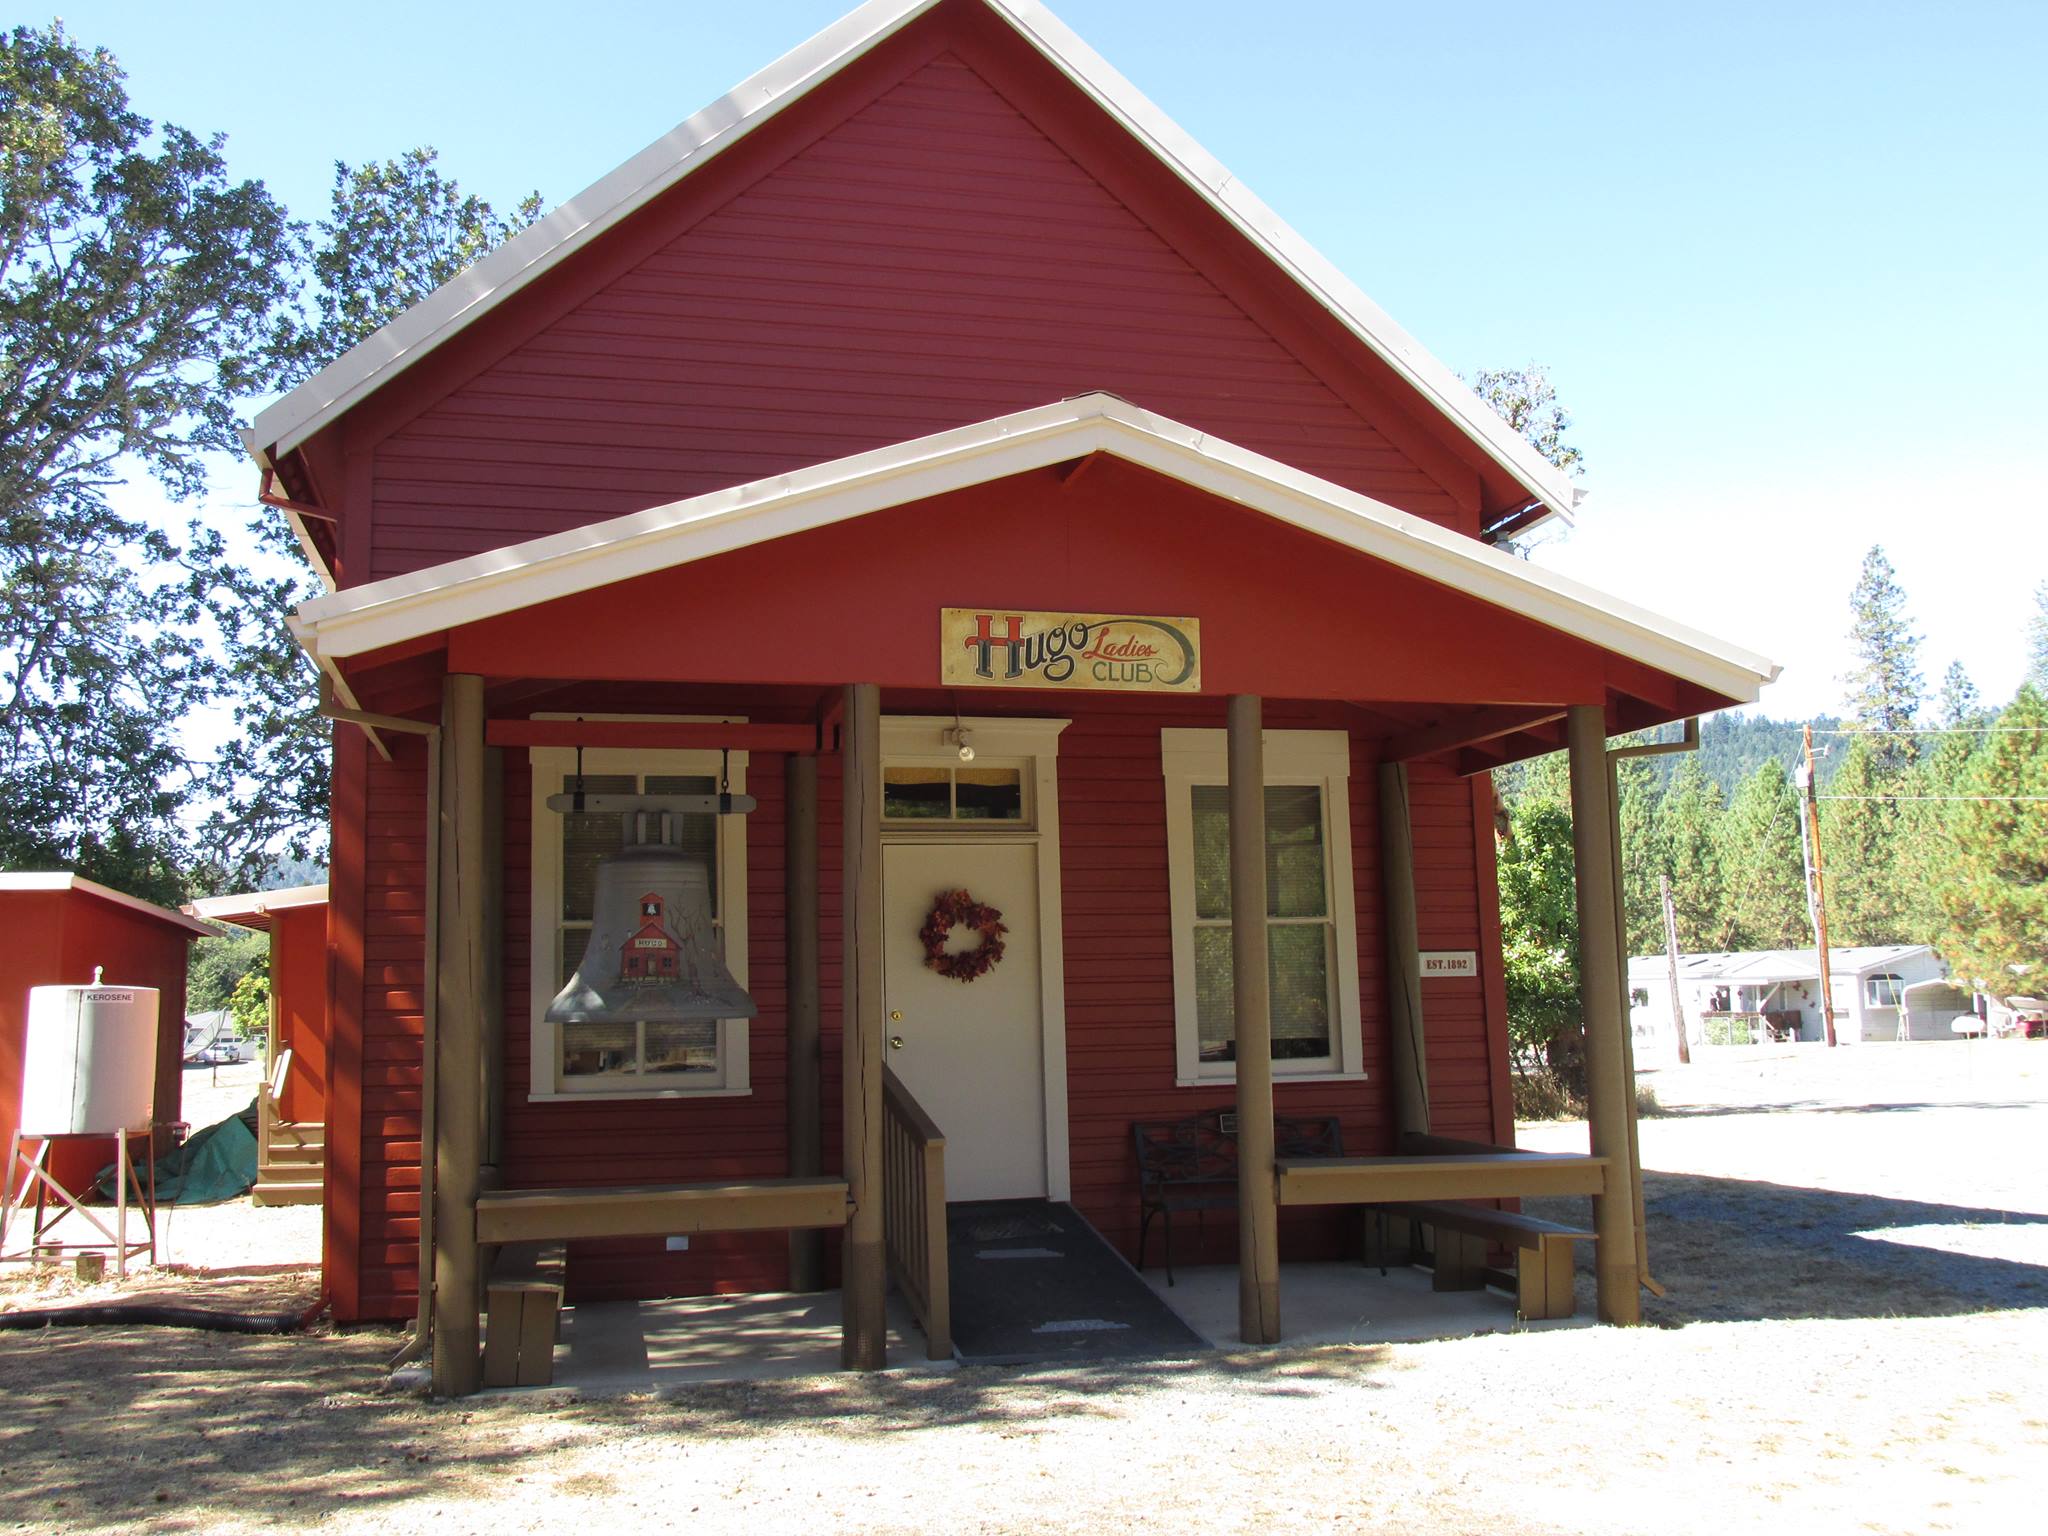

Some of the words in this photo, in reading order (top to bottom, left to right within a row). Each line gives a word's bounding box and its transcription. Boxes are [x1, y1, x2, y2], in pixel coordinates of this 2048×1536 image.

[964, 614, 1089, 682] Hugo
[1082, 627, 1160, 662] Ladies
[1092, 661, 1153, 683] CLUB
[87, 993, 132, 1001] KEROSENE
